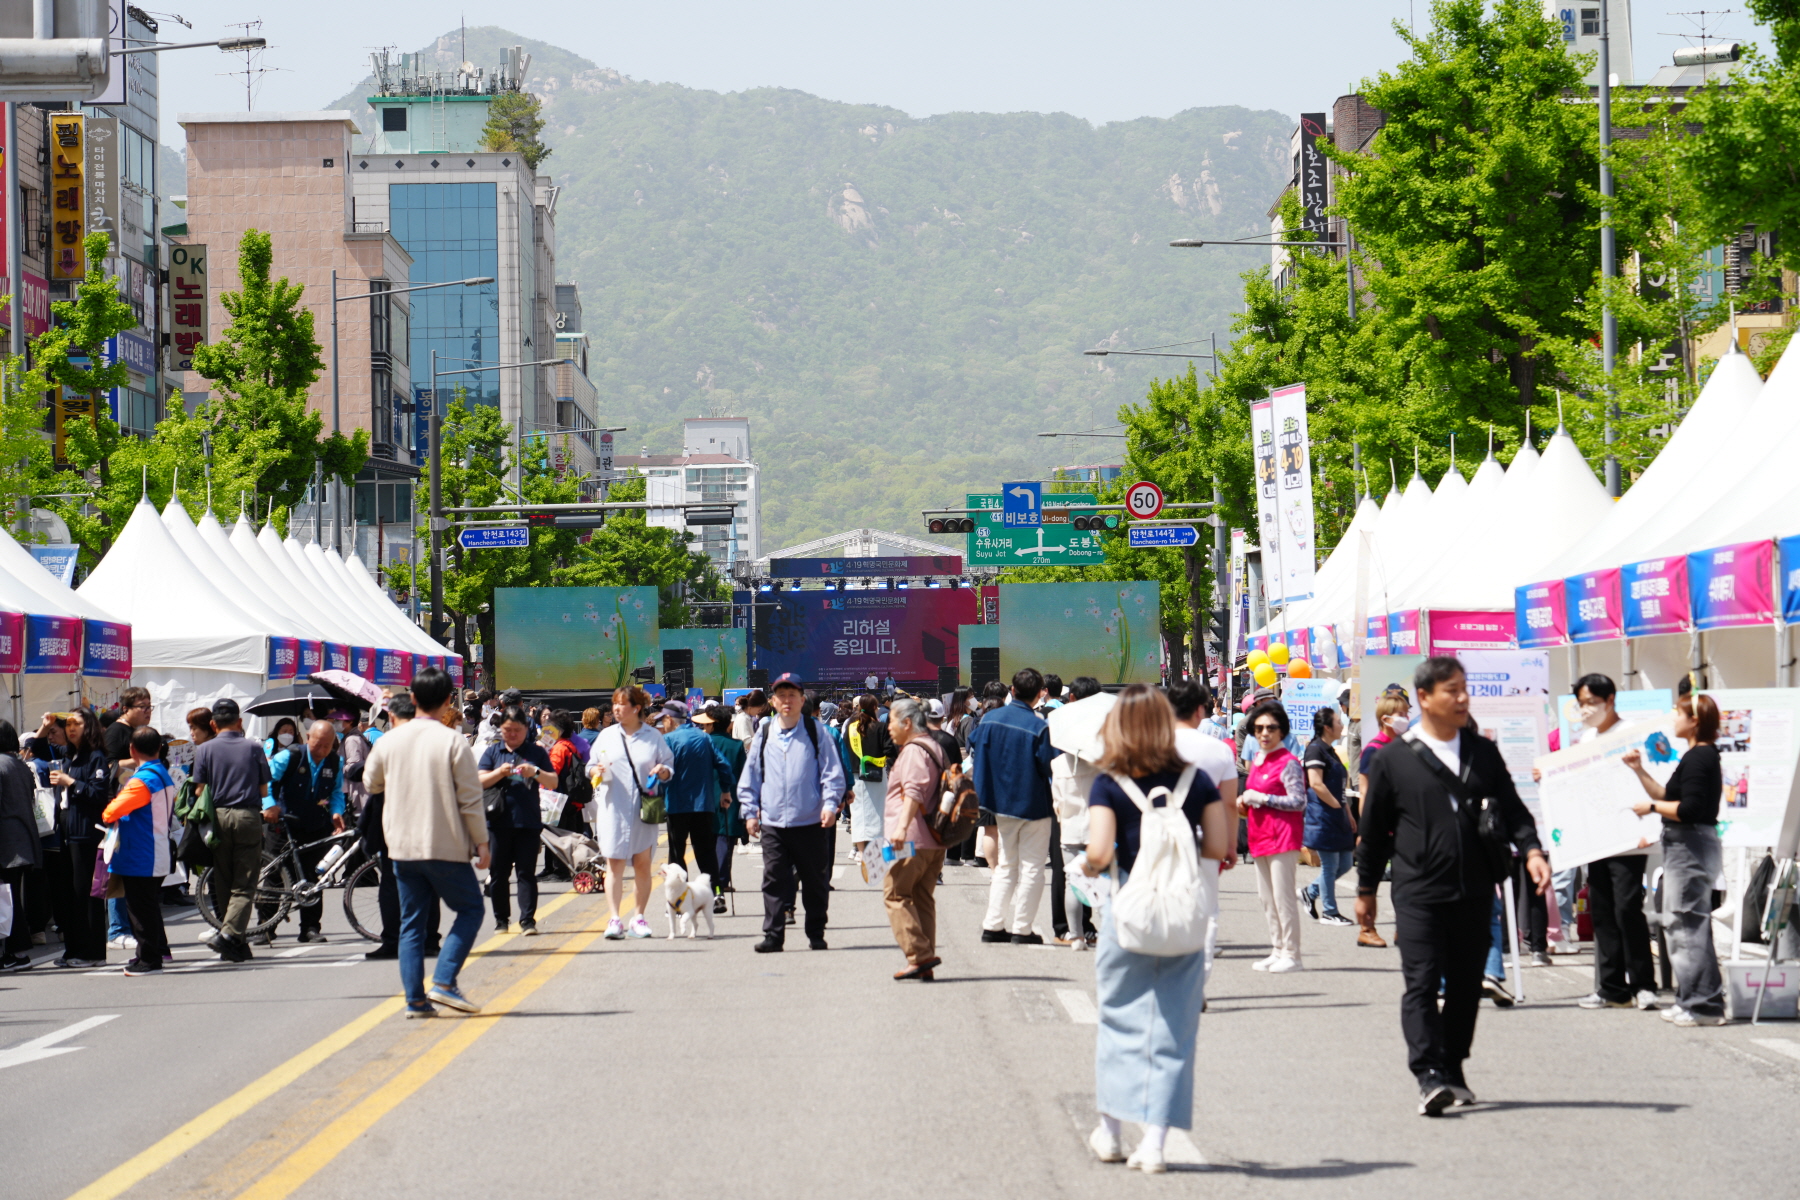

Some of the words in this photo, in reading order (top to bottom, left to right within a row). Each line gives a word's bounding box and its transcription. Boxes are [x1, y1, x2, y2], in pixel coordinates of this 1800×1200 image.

[56, 123, 79, 147] 필
[94, 146, 105, 162] 타이
[94, 163, 105, 179] 전통
[55, 155, 81, 244] 노래방
[94, 181, 105, 204] 마사지
[172, 248, 204, 274] OK
[174, 277, 204, 355] 노래방
[1134, 493, 1155, 508] 50
[1006, 512, 1039, 525] 비보호
[482, 529, 526, 539] 한천로143길
[1131, 529, 1176, 538] 한천로144길
[976, 538, 1012, 548] 수유사거리
[976, 550, 993, 558] Suyu
[843, 619, 890, 636] 리허설
[833, 639, 901, 655] 중입니다.
